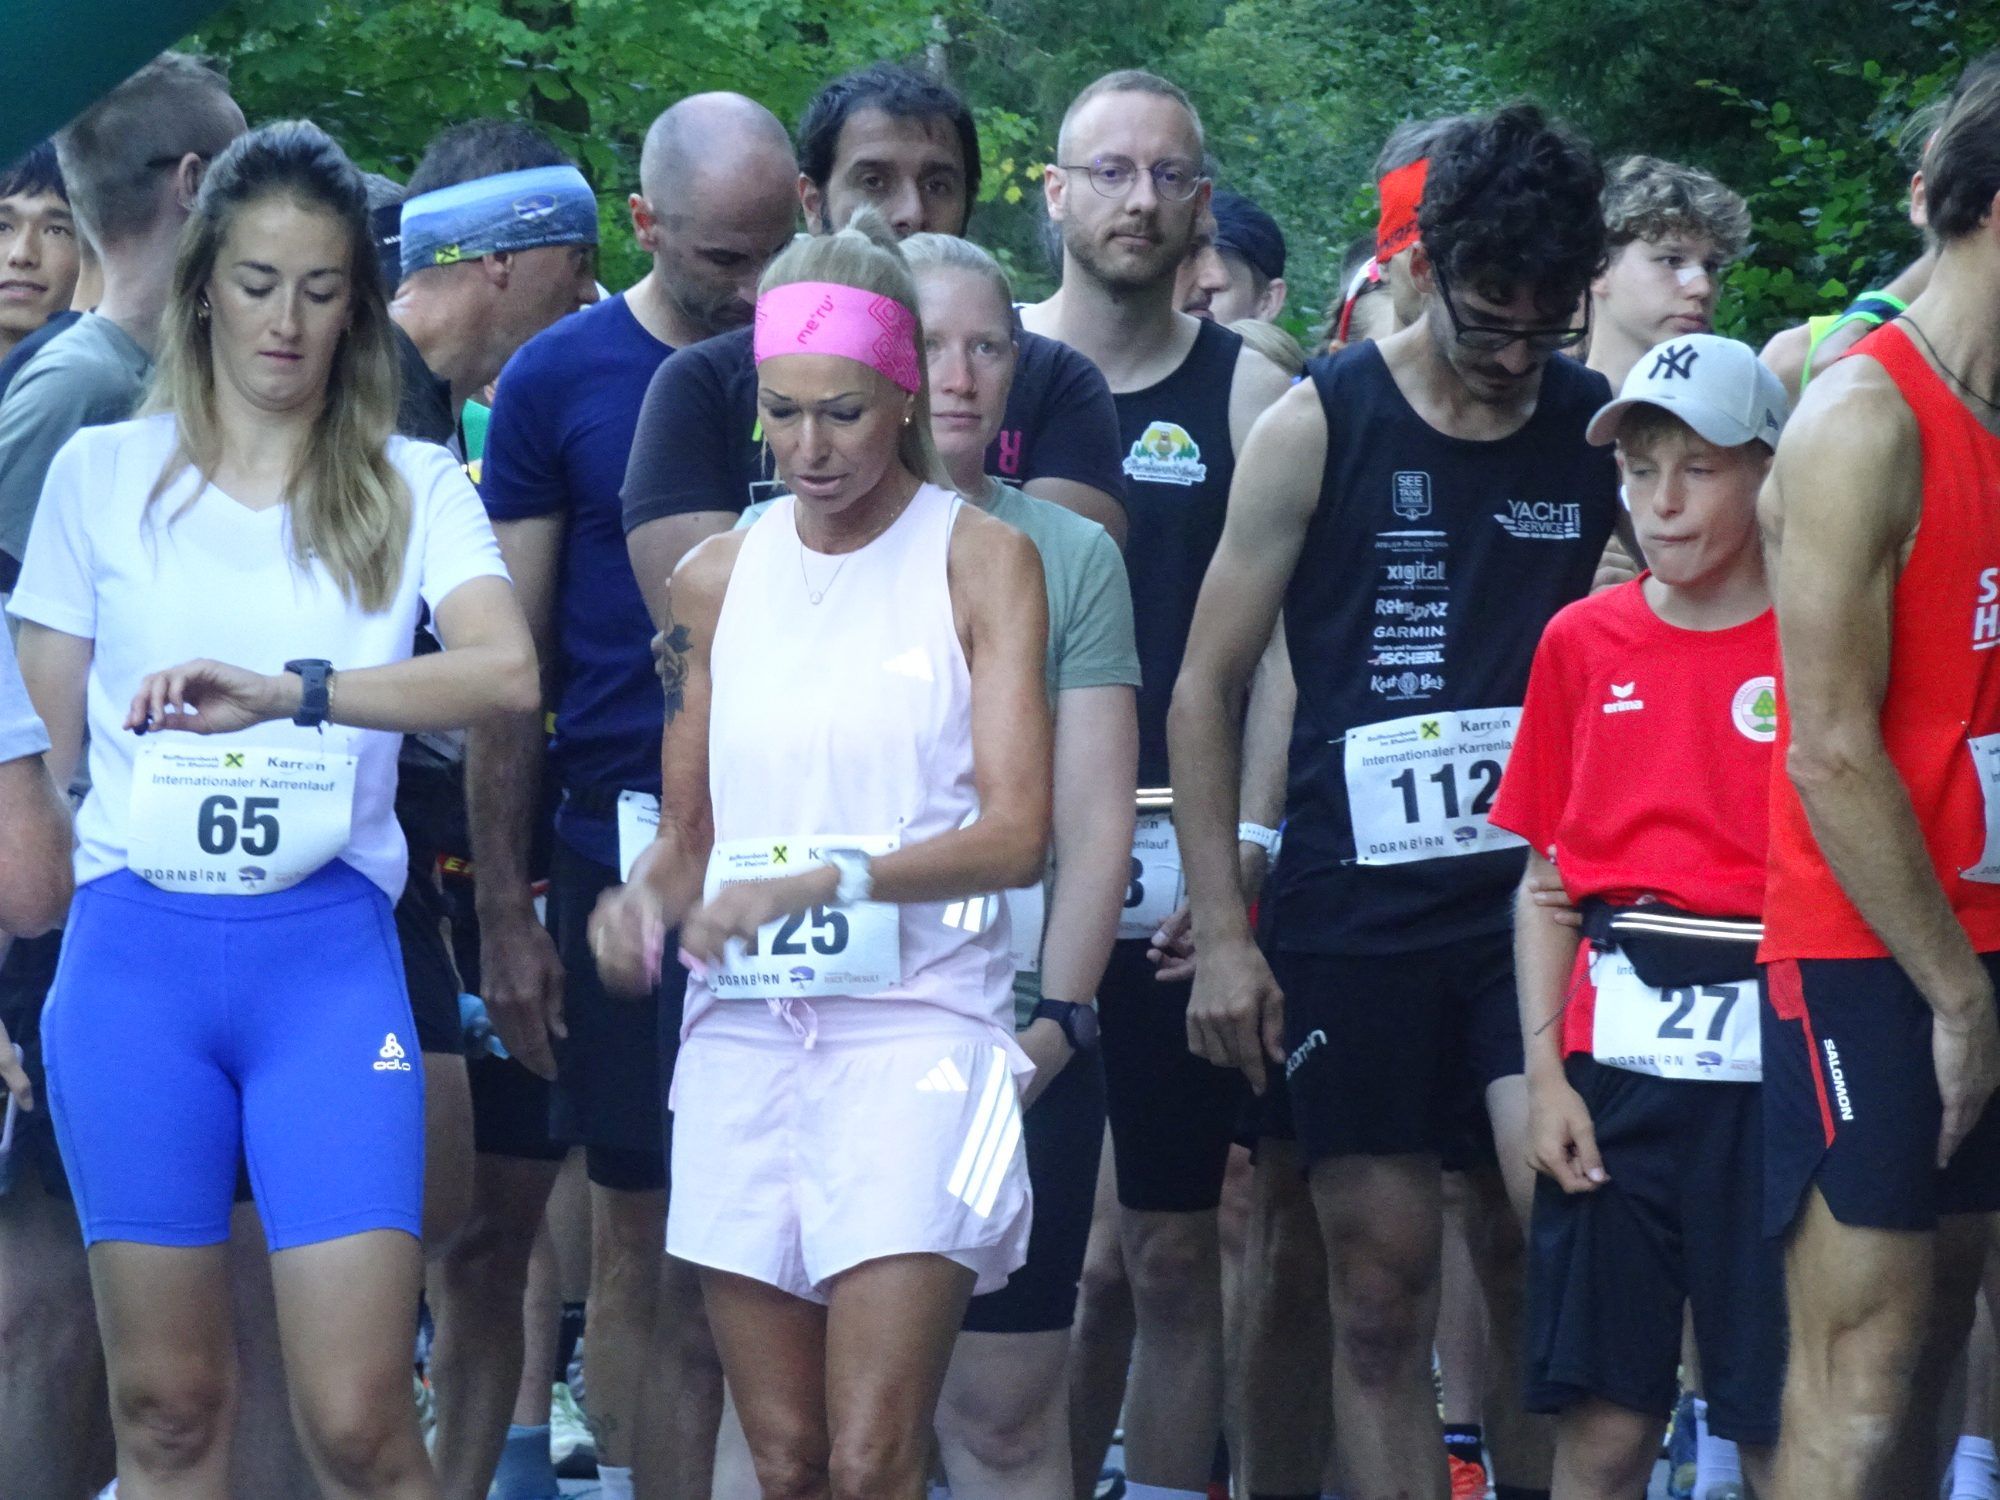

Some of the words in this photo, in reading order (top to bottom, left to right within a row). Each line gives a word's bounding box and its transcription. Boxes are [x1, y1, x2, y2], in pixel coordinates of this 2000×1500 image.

[1648, 344, 1699, 379] NY
[1398, 475, 1423, 487] SEE
[1507, 499, 1580, 521] YACHT
[1518, 521, 1564, 533] SERVICE
[1373, 625, 1445, 638] GARMIN
[1362, 747, 1455, 766] Internationaler
[1458, 740, 1513, 754] Karrenla
[152, 773, 255, 788] Internationaler
[260, 778, 335, 791] Karrenlauf
[1391, 759, 1502, 823] 112
[197, 794, 280, 856] 65
[1370, 836, 1444, 854] DORNBIRN
[144, 867, 227, 882] DORNBIRN
[718, 973, 780, 986] DORNBIRN
[1657, 986, 1739, 1041] 27
[373, 1059, 411, 1071] odlo
[1823, 1039, 1854, 1120] SALOMON
